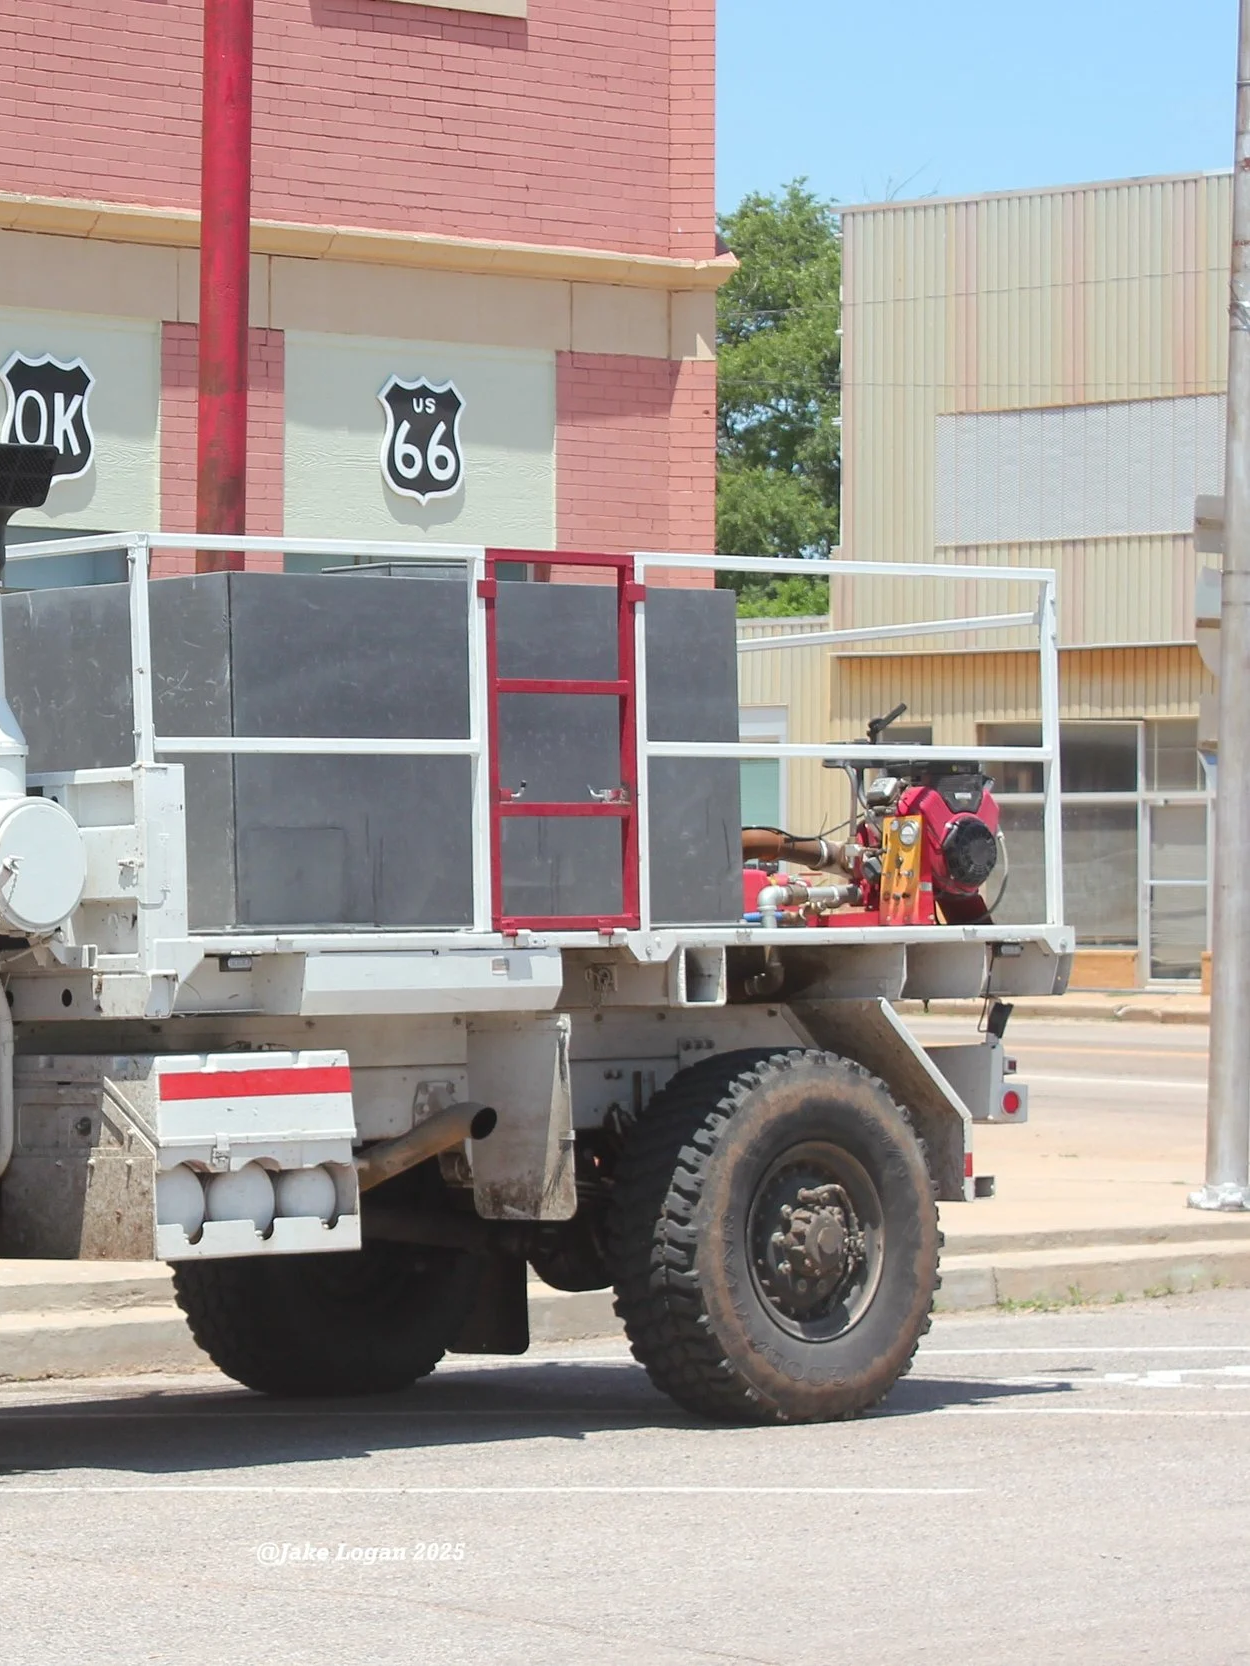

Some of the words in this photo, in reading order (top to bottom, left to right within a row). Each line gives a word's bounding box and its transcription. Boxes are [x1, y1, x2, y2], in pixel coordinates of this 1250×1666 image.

[14, 389, 83, 456] OK
[412, 397, 436, 414] US
[394, 419, 456, 481] 66
